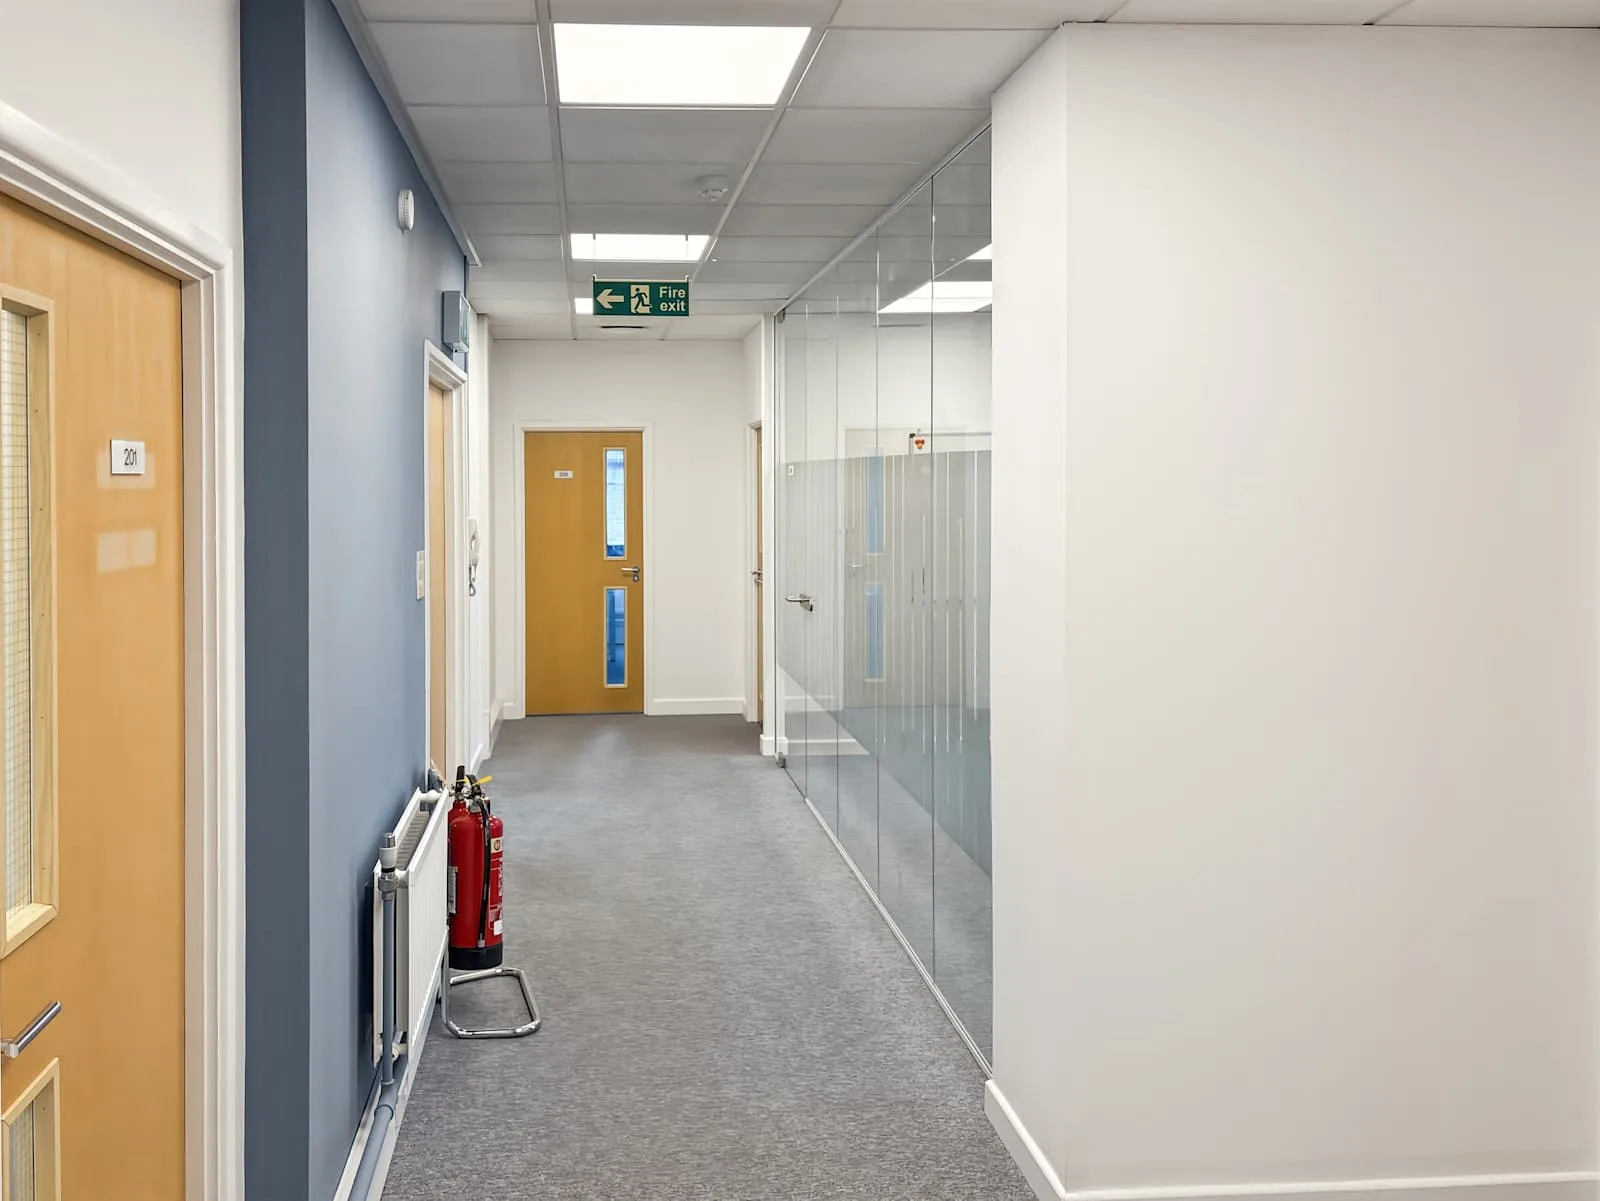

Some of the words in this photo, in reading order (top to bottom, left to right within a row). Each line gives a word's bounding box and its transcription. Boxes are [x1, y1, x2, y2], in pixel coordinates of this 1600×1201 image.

[659, 286, 686, 298] Fire
[660, 300, 685, 312] exit
[124, 448, 137, 466] 201
